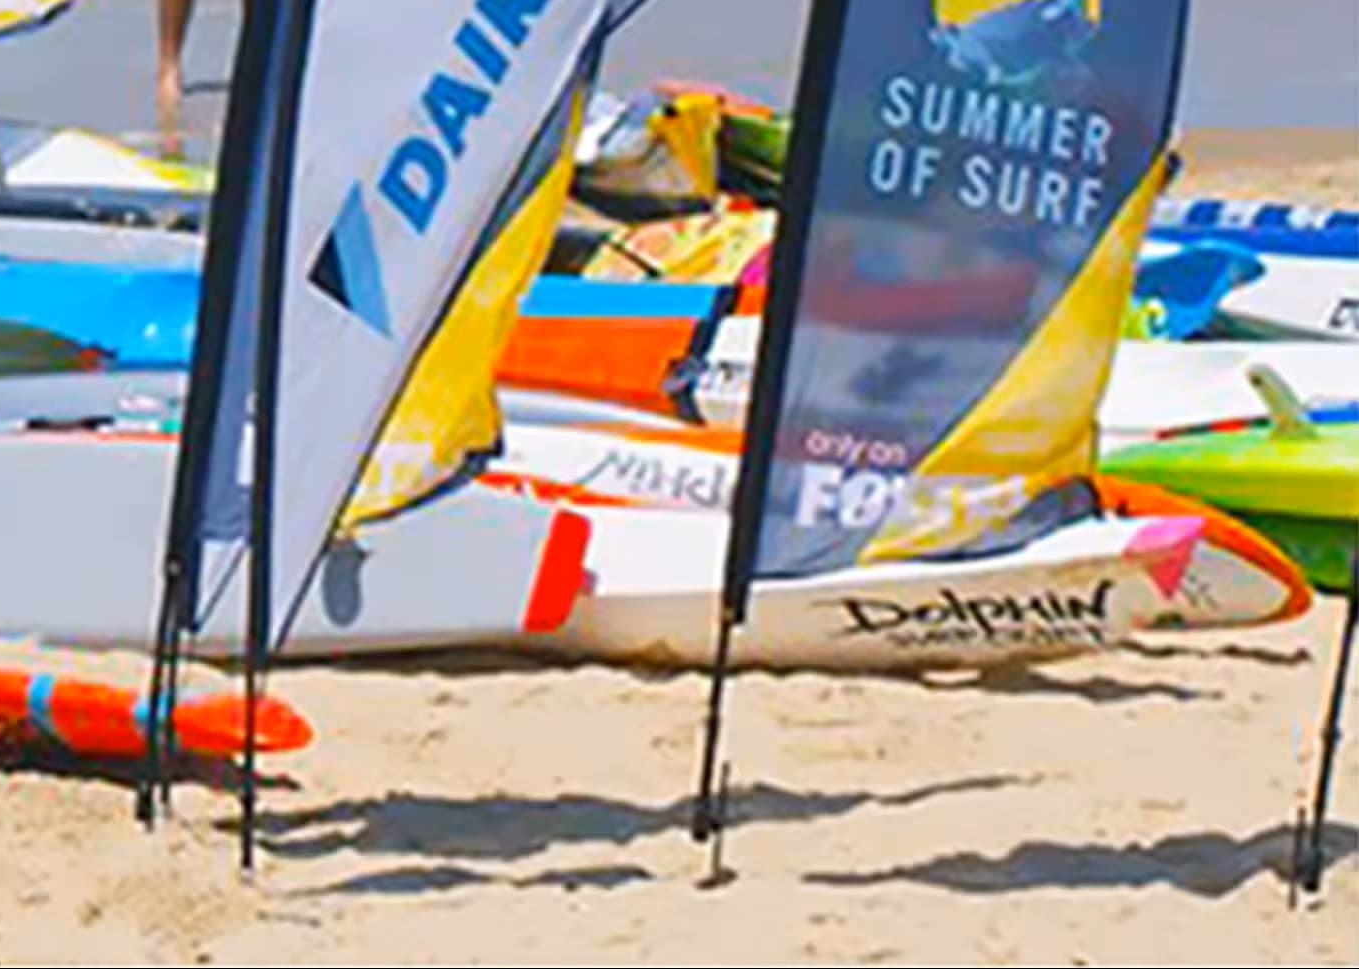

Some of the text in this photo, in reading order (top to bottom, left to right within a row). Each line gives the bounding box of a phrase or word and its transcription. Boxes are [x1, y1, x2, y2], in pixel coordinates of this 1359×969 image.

[881, 76, 1113, 165] SUMMER
[871, 141, 1104, 227] OF SURF
